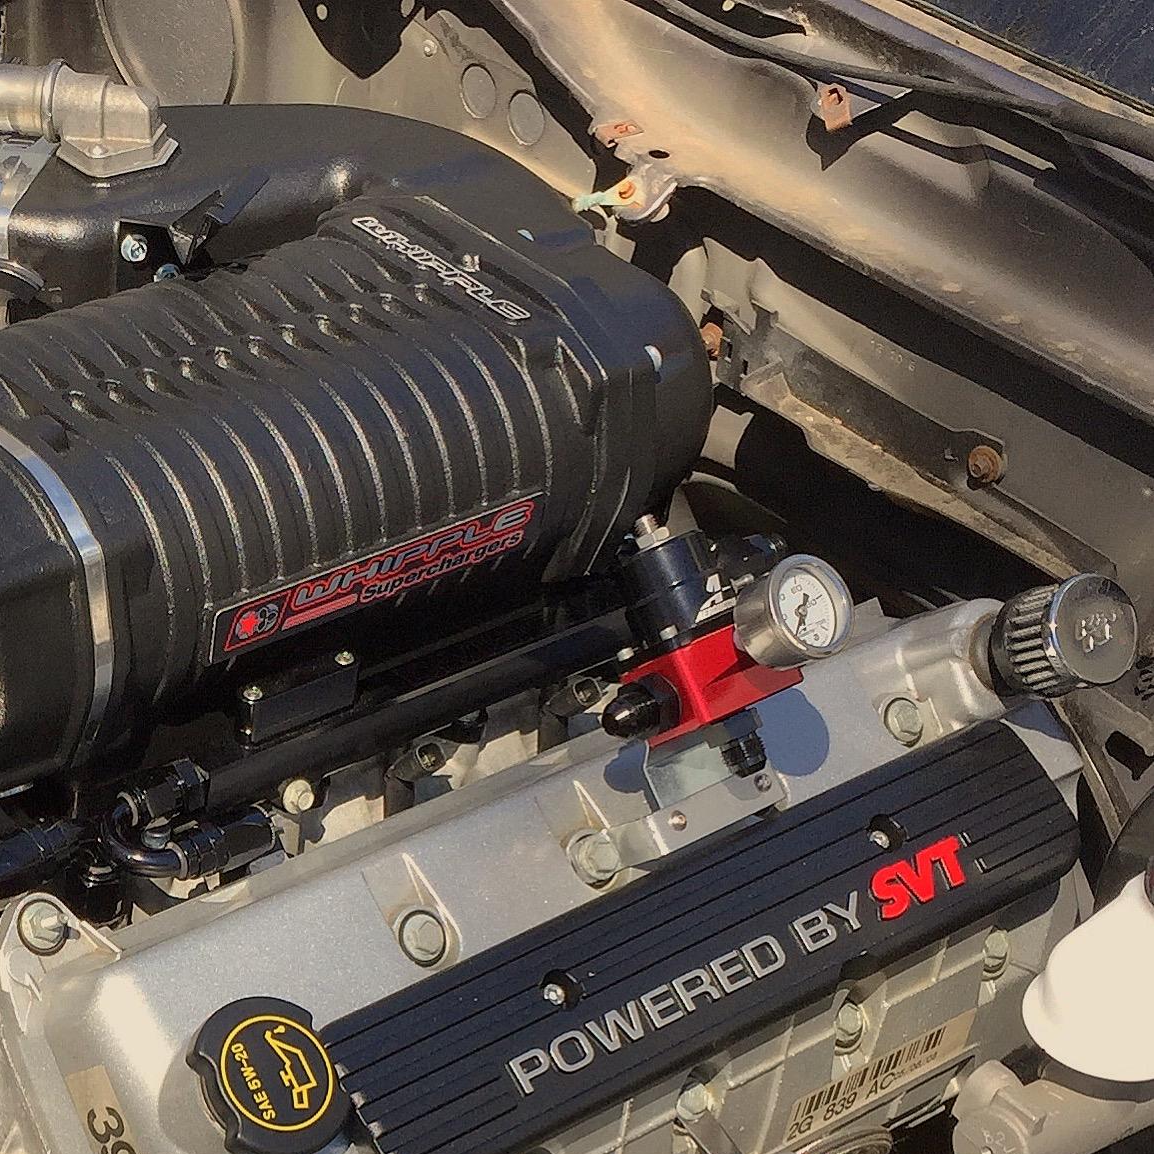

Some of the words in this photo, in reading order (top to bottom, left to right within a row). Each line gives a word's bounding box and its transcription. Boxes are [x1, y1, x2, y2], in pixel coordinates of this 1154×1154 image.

[293, 502, 533, 607] WHIPPLE
[360, 531, 524, 602] Superchargers
[507, 934, 786, 1097] POWERED
[791, 890, 861, 954] BY
[869, 834, 967, 920] SVT
[232, 1043, 262, 1090] 5W-20
[253, 1090, 276, 1121] SAE
[786, 1116, 813, 1141] 2G
[823, 1092, 857, 1121] 839
[866, 1074, 895, 1100] AC
